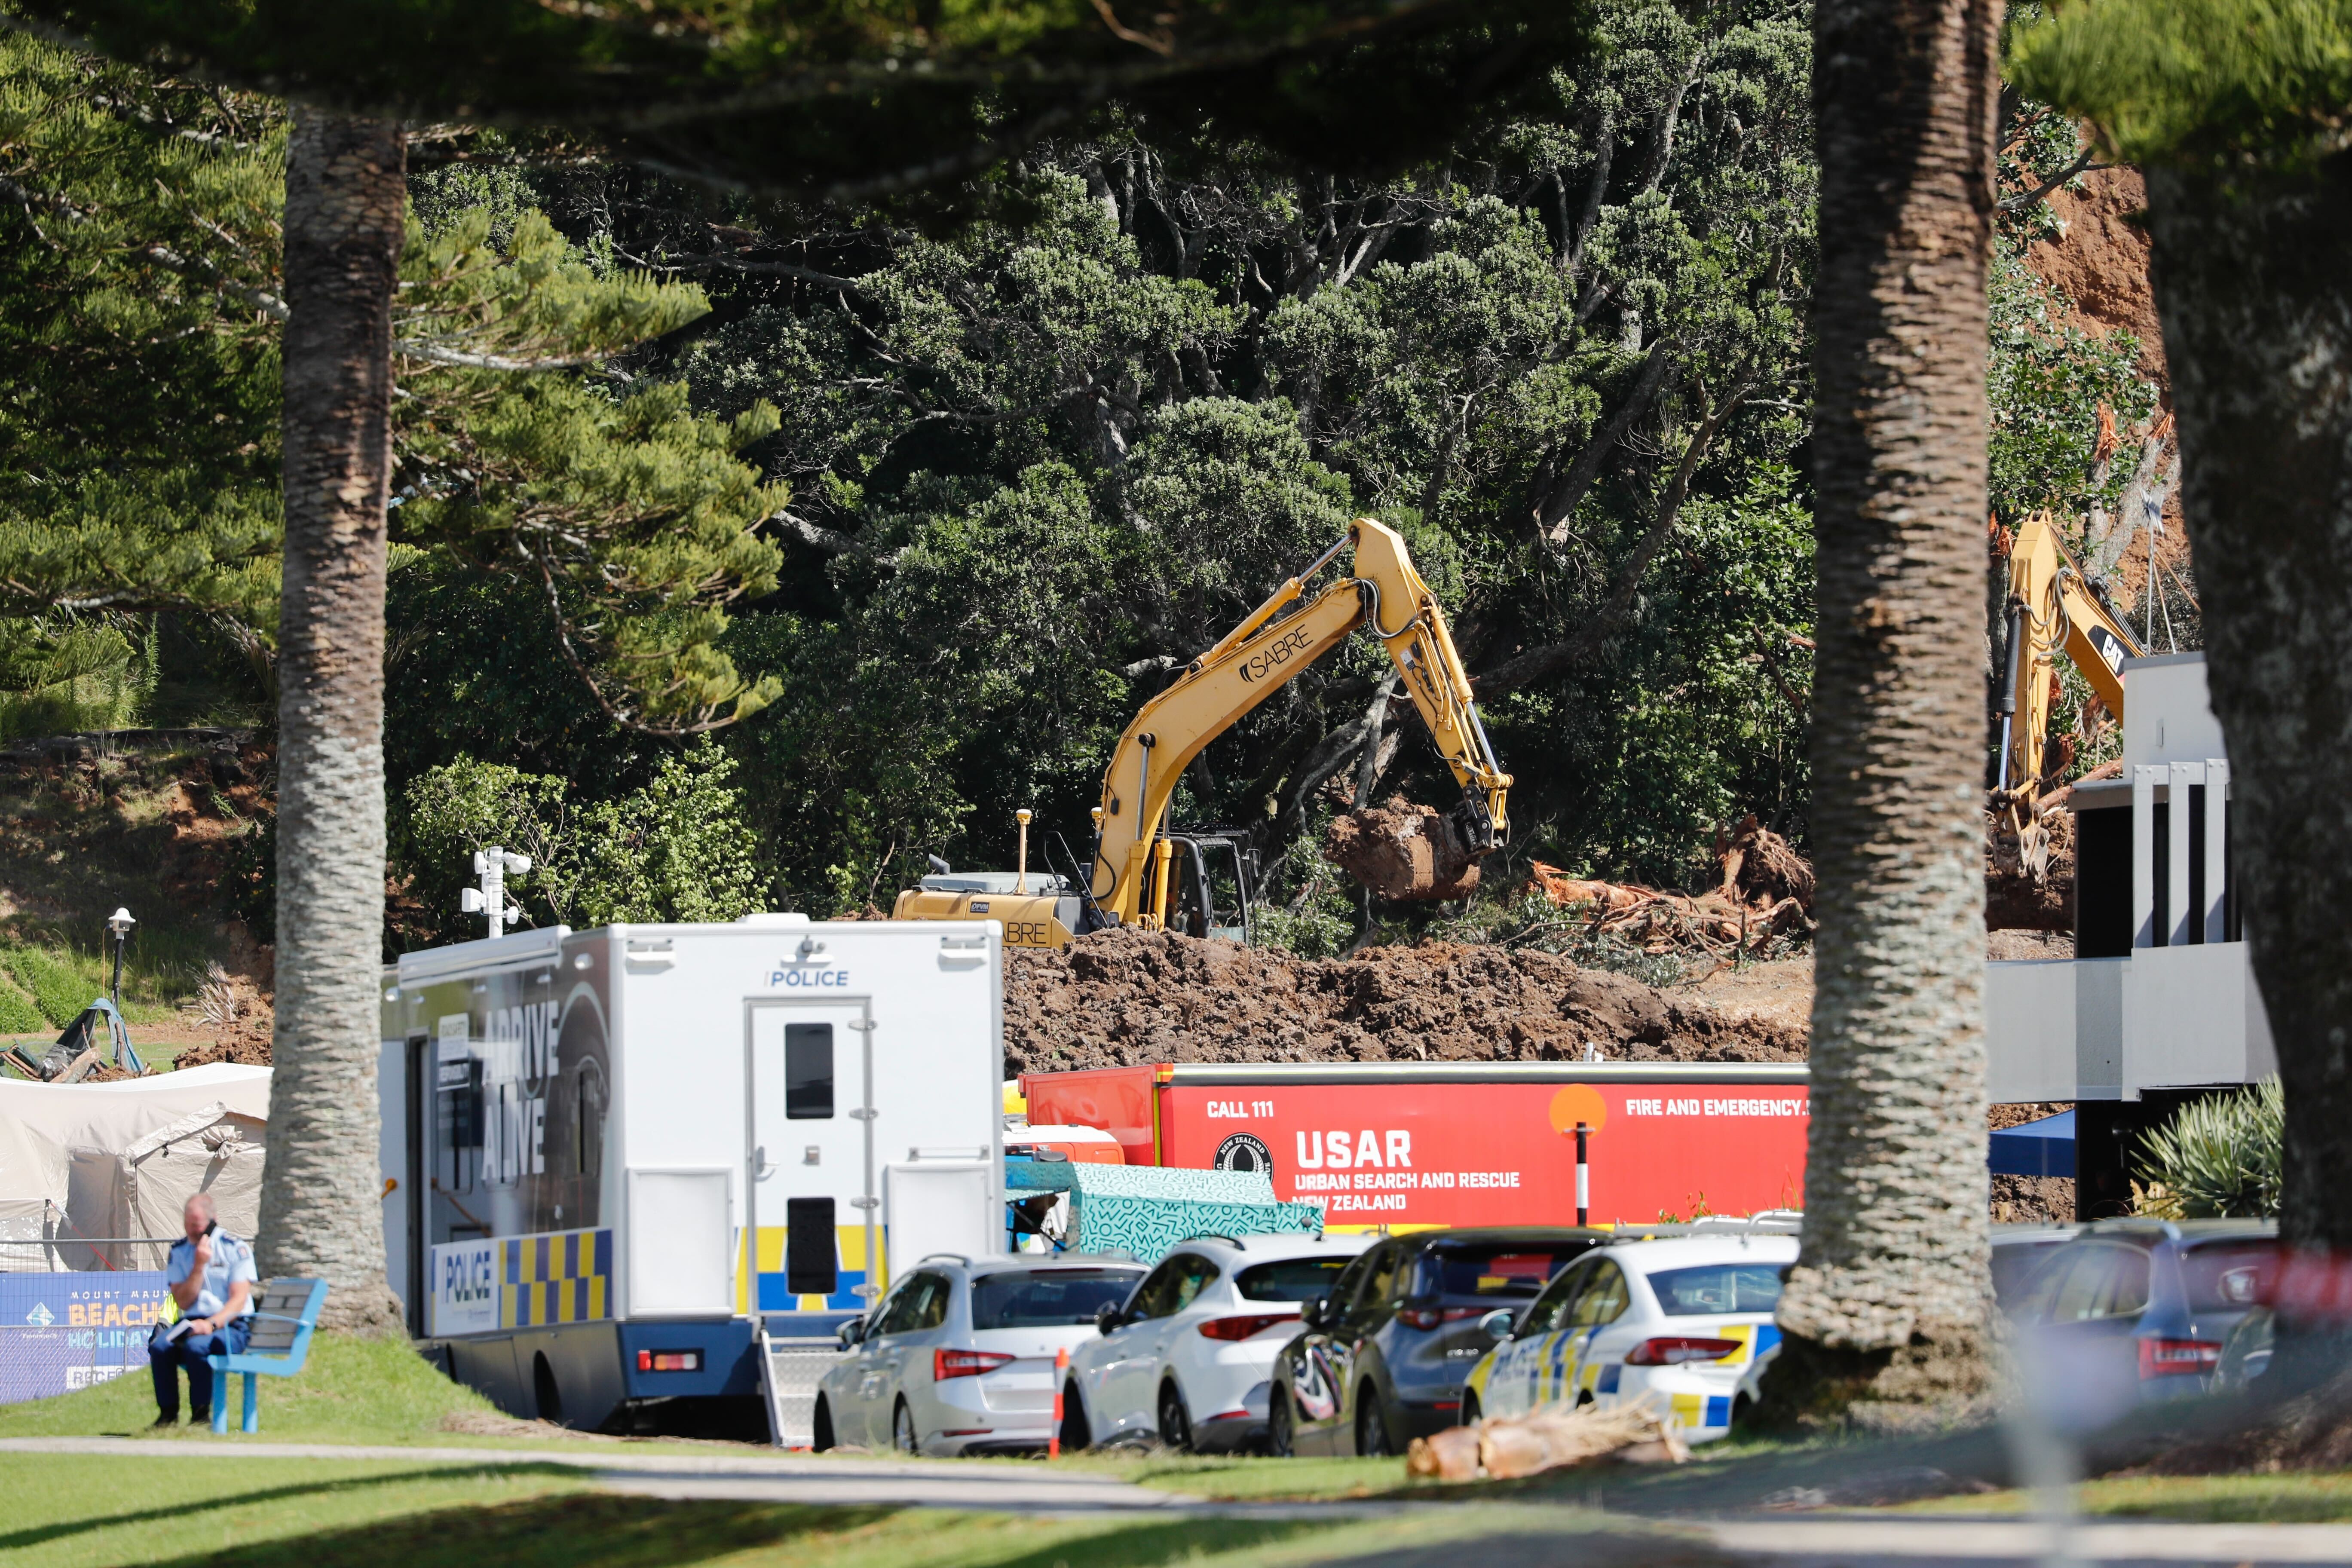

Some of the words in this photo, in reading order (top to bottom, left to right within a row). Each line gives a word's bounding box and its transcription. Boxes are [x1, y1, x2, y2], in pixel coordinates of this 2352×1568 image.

[1250, 624, 1314, 678] SABRE
[2103, 634, 2124, 673] CAT
[771, 971, 848, 987] POLICE
[482, 1000, 559, 1087] ARRIVE
[1207, 1101, 1249, 1118] CALL
[1251, 1100, 1274, 1118] 111
[1626, 1099, 1663, 1115] FIRE
[1666, 1099, 1700, 1115] AND
[481, 1097, 545, 1180] ALIVE
[1220, 1139, 1234, 1155] NEW
[1234, 1136, 1265, 1154] ZEALAND
[1296, 1130, 1412, 1169] USAR
[1295, 1173, 1350, 1190] URBAN
[1354, 1173, 1418, 1189] SEARCH
[1421, 1172, 1455, 1188] AND
[1459, 1172, 1520, 1188] RESCUE
[1332, 1194, 1406, 1211] ZEALAND
[446, 1250, 491, 1304] POLICE
[71, 1290, 120, 1299] MOUNT
[69, 1301, 163, 1327] BEACH
